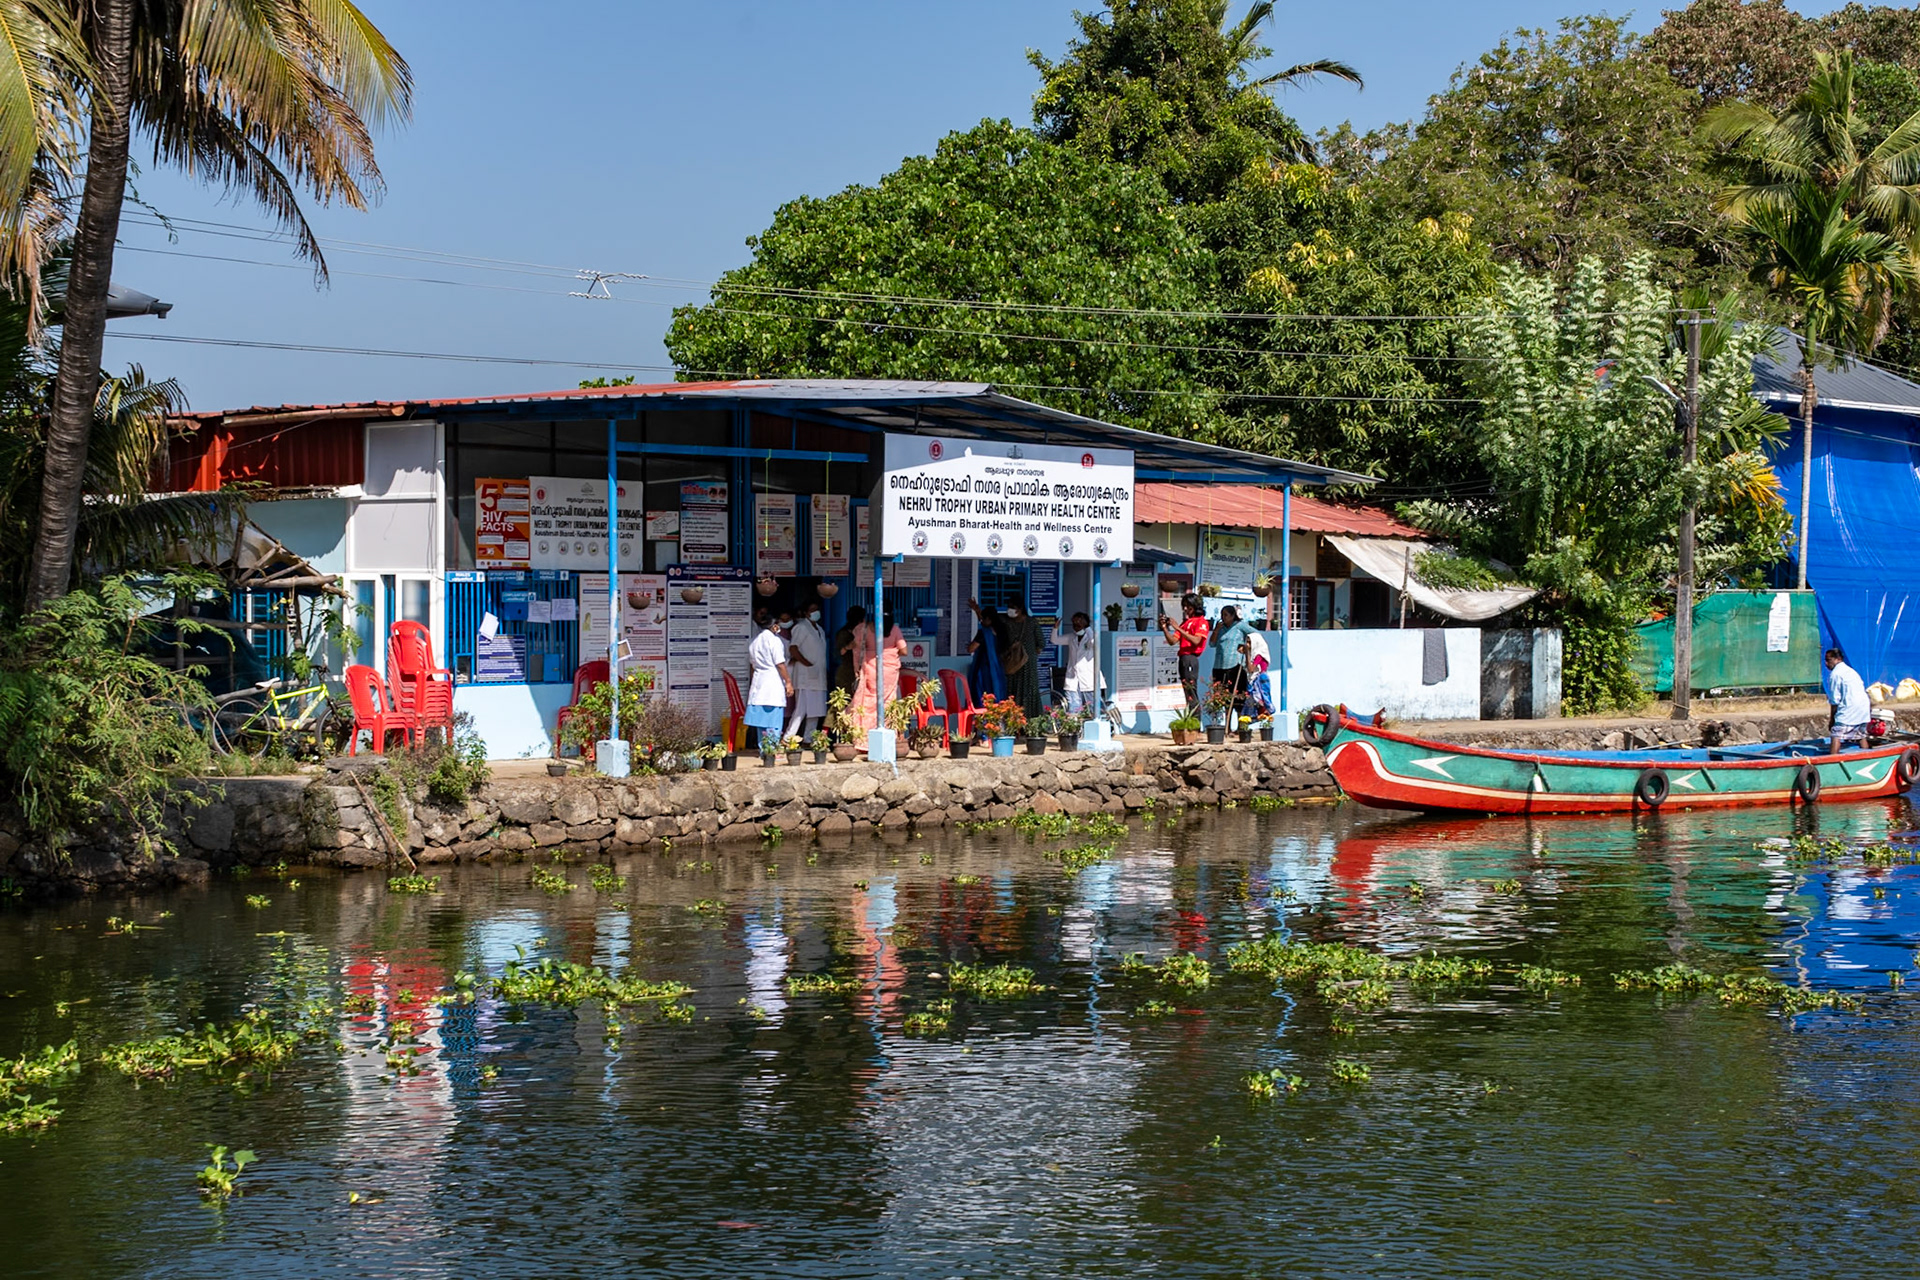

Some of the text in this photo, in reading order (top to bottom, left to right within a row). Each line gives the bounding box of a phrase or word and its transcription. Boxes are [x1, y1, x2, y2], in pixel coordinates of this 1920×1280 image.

[480, 484, 498, 511] 5
[974, 480, 1001, 494] നഗര
[1003, 479, 1050, 499] പ്രാഥമിക
[1053, 484, 1129, 504] ആരോഗ്യകേന്ദ്രം
[481, 511, 502, 522] HIV
[899, 496, 1121, 520] NEHRU TROPHY URBAN PRIMARY HEALTH CENTRE
[480, 522, 515, 532] FACTS
[534, 519, 552, 529] NEHRU
[555, 520, 572, 529] TROPHY
[573, 520, 588, 529] URBAN
[588, 520, 608, 530] PRIMARY
[626, 522, 641, 530] CENTRE
[908, 516, 1113, 534] Ayushman Bharat-Health and Wellness Centre
